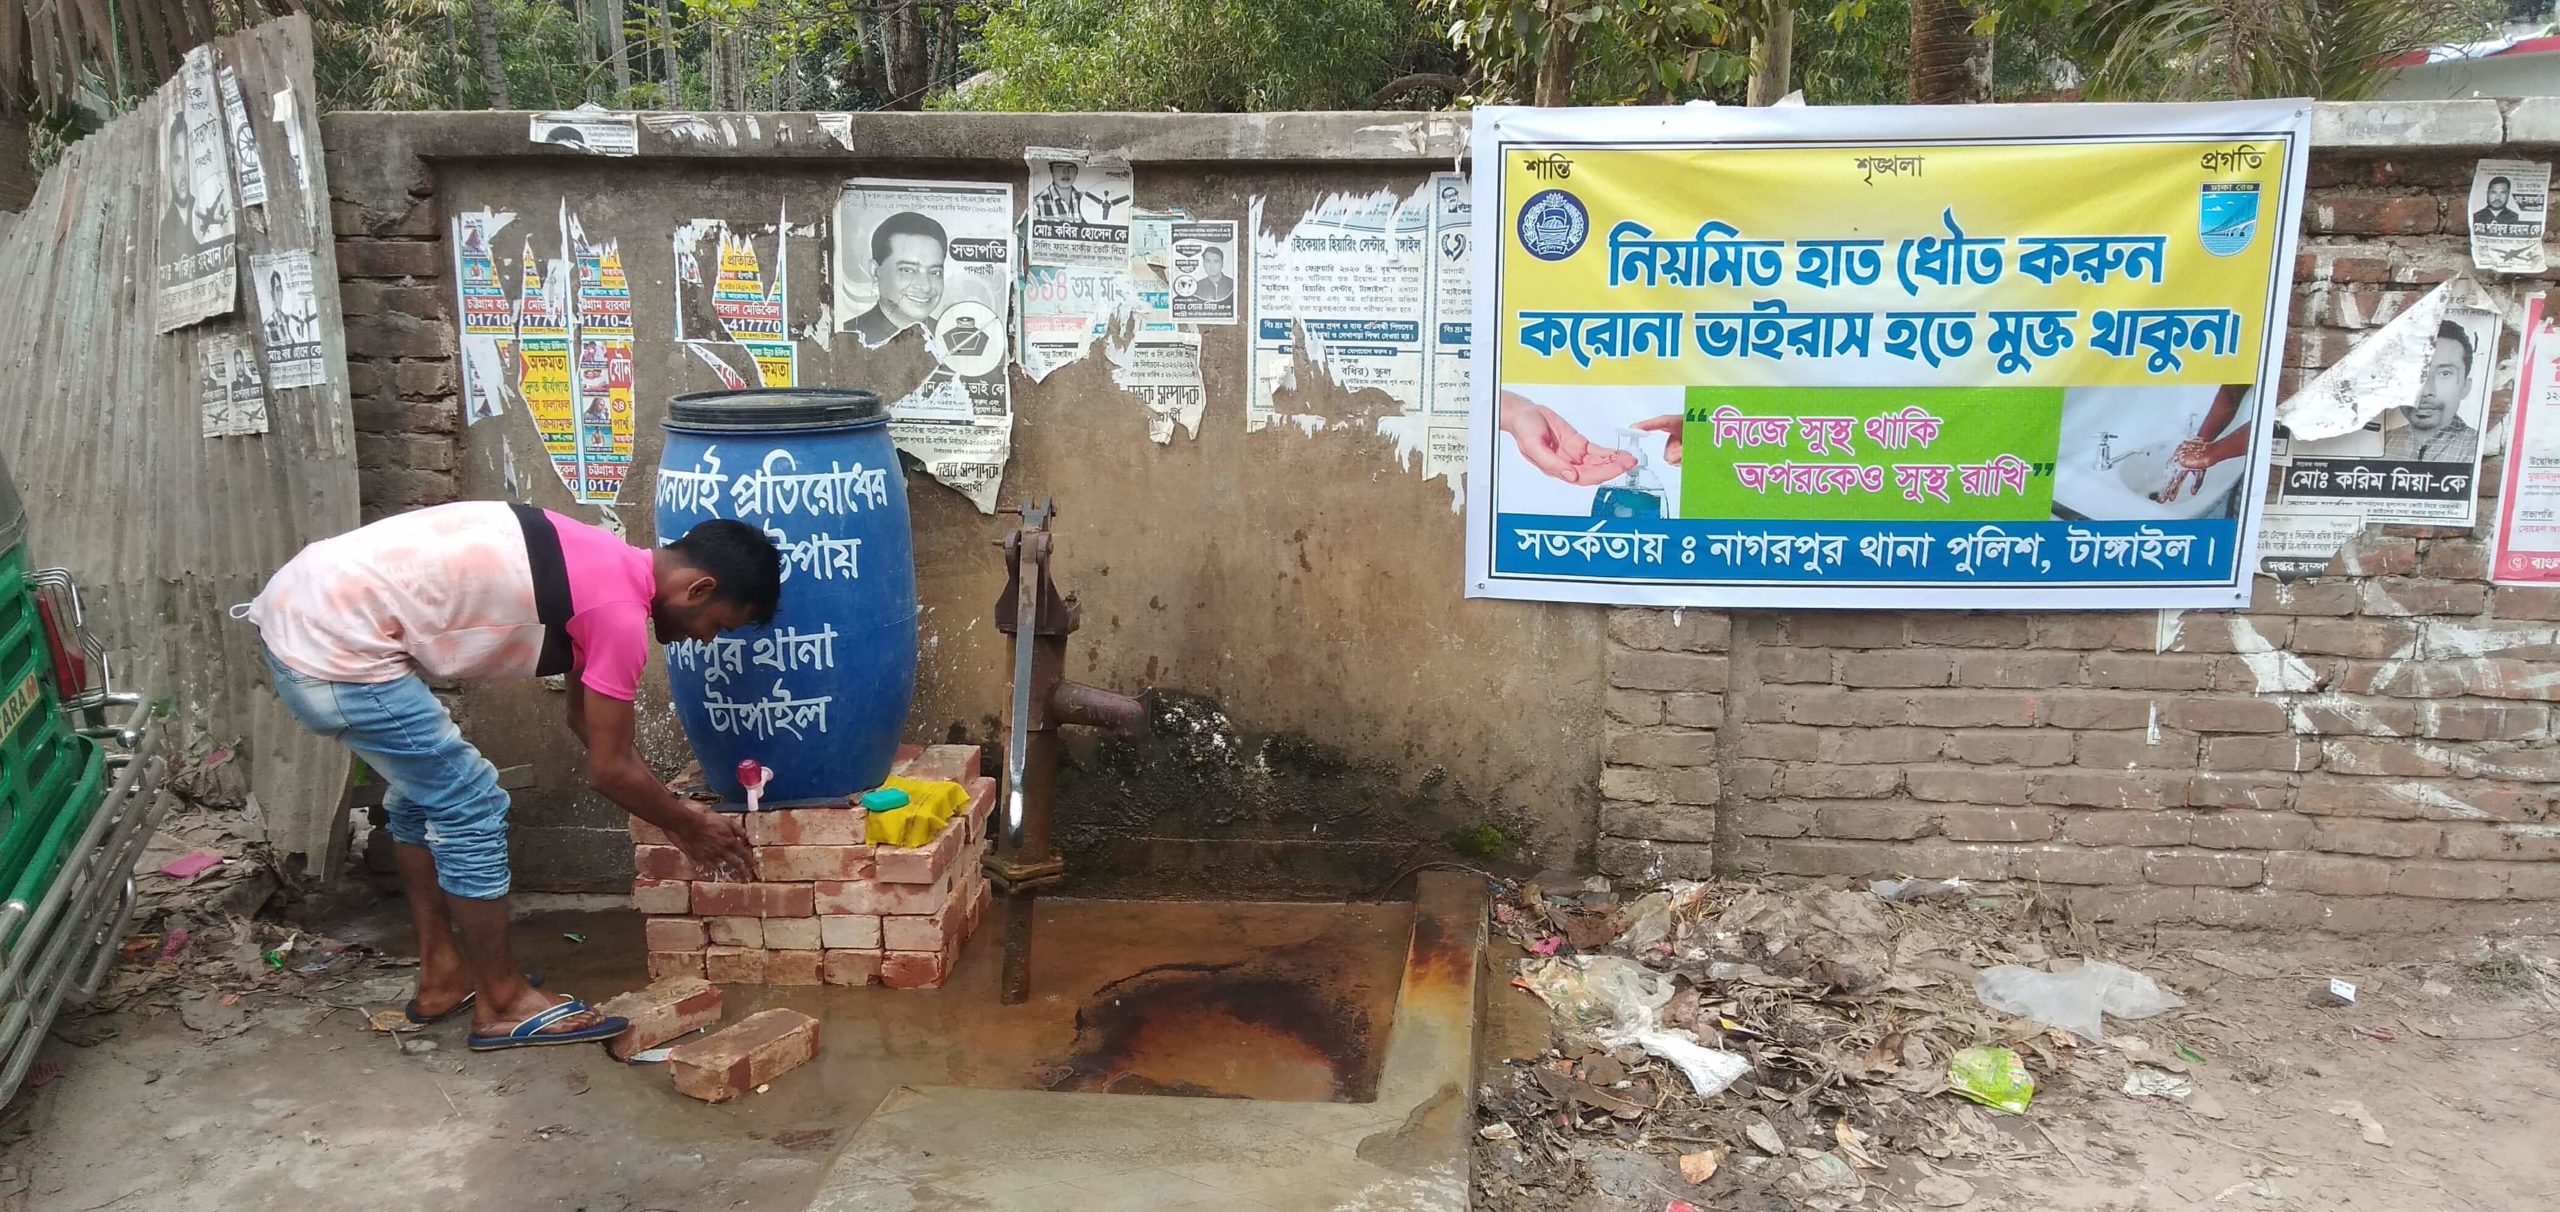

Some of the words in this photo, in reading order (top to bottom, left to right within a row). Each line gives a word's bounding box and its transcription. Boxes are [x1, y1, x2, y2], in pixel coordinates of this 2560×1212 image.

[1524, 153, 1574, 180] শান্তি
[1854, 154, 1926, 187] শৃঙ্খলা
[2200, 144, 2267, 174] প্রগতি
[951, 240, 1006, 259] সভাপতি
[1034, 225, 1052, 236] মোঃ
[1054, 222, 1078, 239] কবির
[1081, 227, 1112, 240] হোসেন
[1115, 229, 1127, 241] কে
[1329, 234, 1356, 254] হিয়ারিং
[1396, 235, 1421, 254] াঙ্গাইল
[1609, 221, 1785, 288] নিয়মিত
[1796, 239, 1885, 289] হাত
[1897, 205, 2005, 297] ধৌত
[2018, 236, 2166, 285] করুন
[1519, 312, 1683, 368] করোনা
[1695, 298, 1873, 361] ভাইরাস
[1884, 312, 1976, 369] হতে
[1987, 310, 2077, 375] মুক্ত
[1157, 385, 1199, 404] সম্পাদক
[1800, 416, 1855, 455] সুস্থ
[1866, 406, 1944, 449] থাকি
[730, 449, 887, 518] প্রতিরোধের
[960, 462, 999, 479] সম্পাদক
[1735, 463, 1884, 495] অপরকেও
[1894, 463, 1952, 502] সুস্থ
[2291, 469, 2329, 489] মোঃ
[2335, 466, 2386, 490] করিম
[2390, 467, 2469, 493] মিয়া-কে
[763, 518, 861, 584] উপায়
[1514, 520, 1670, 565] সতর্কতায়
[1706, 531, 1850, 574] নাগরপুর
[1860, 530, 1936, 569] থানা
[1947, 525, 2051, 575] পুলিশ,
[753, 623, 838, 671] থানা
[703, 678, 832, 740] টাঙ্গাইল
